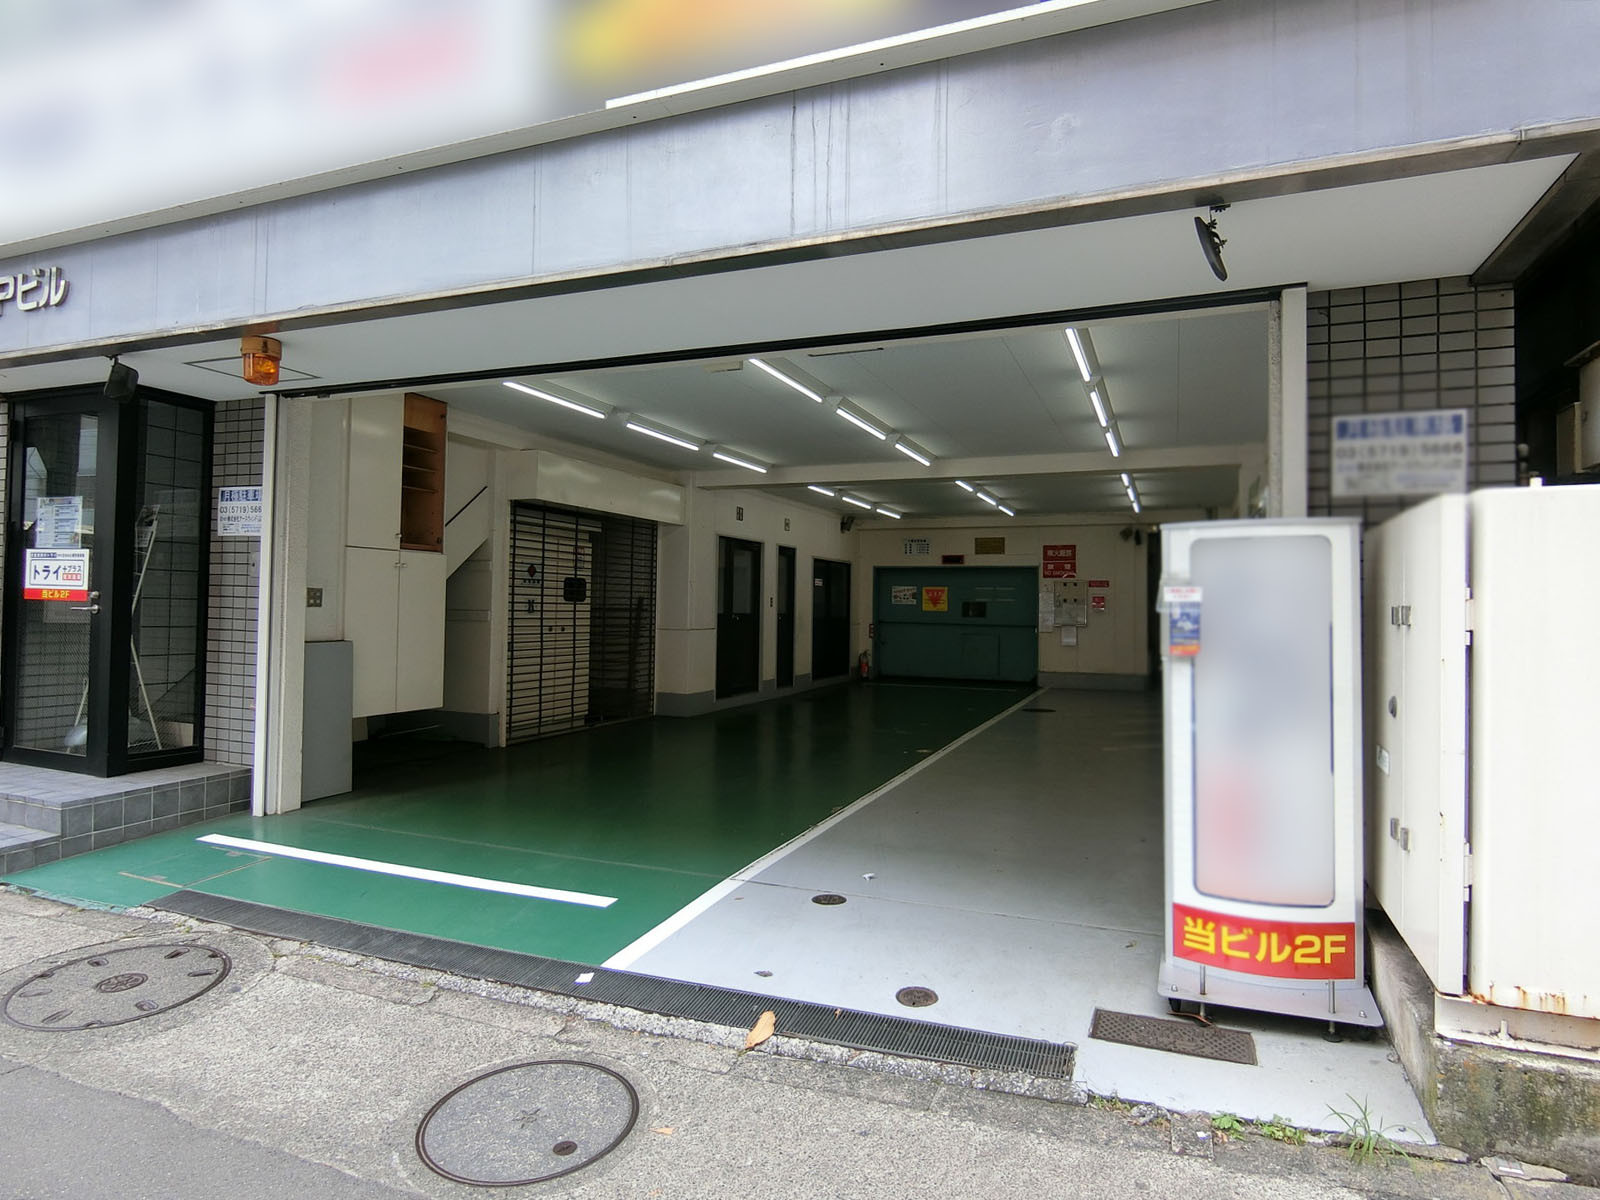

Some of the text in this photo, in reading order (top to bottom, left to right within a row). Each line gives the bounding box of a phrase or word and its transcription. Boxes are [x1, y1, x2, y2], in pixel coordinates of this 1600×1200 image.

[33, 564, 62, 581] トライ
[1183, 915, 1347, 965] 当ビル2F
